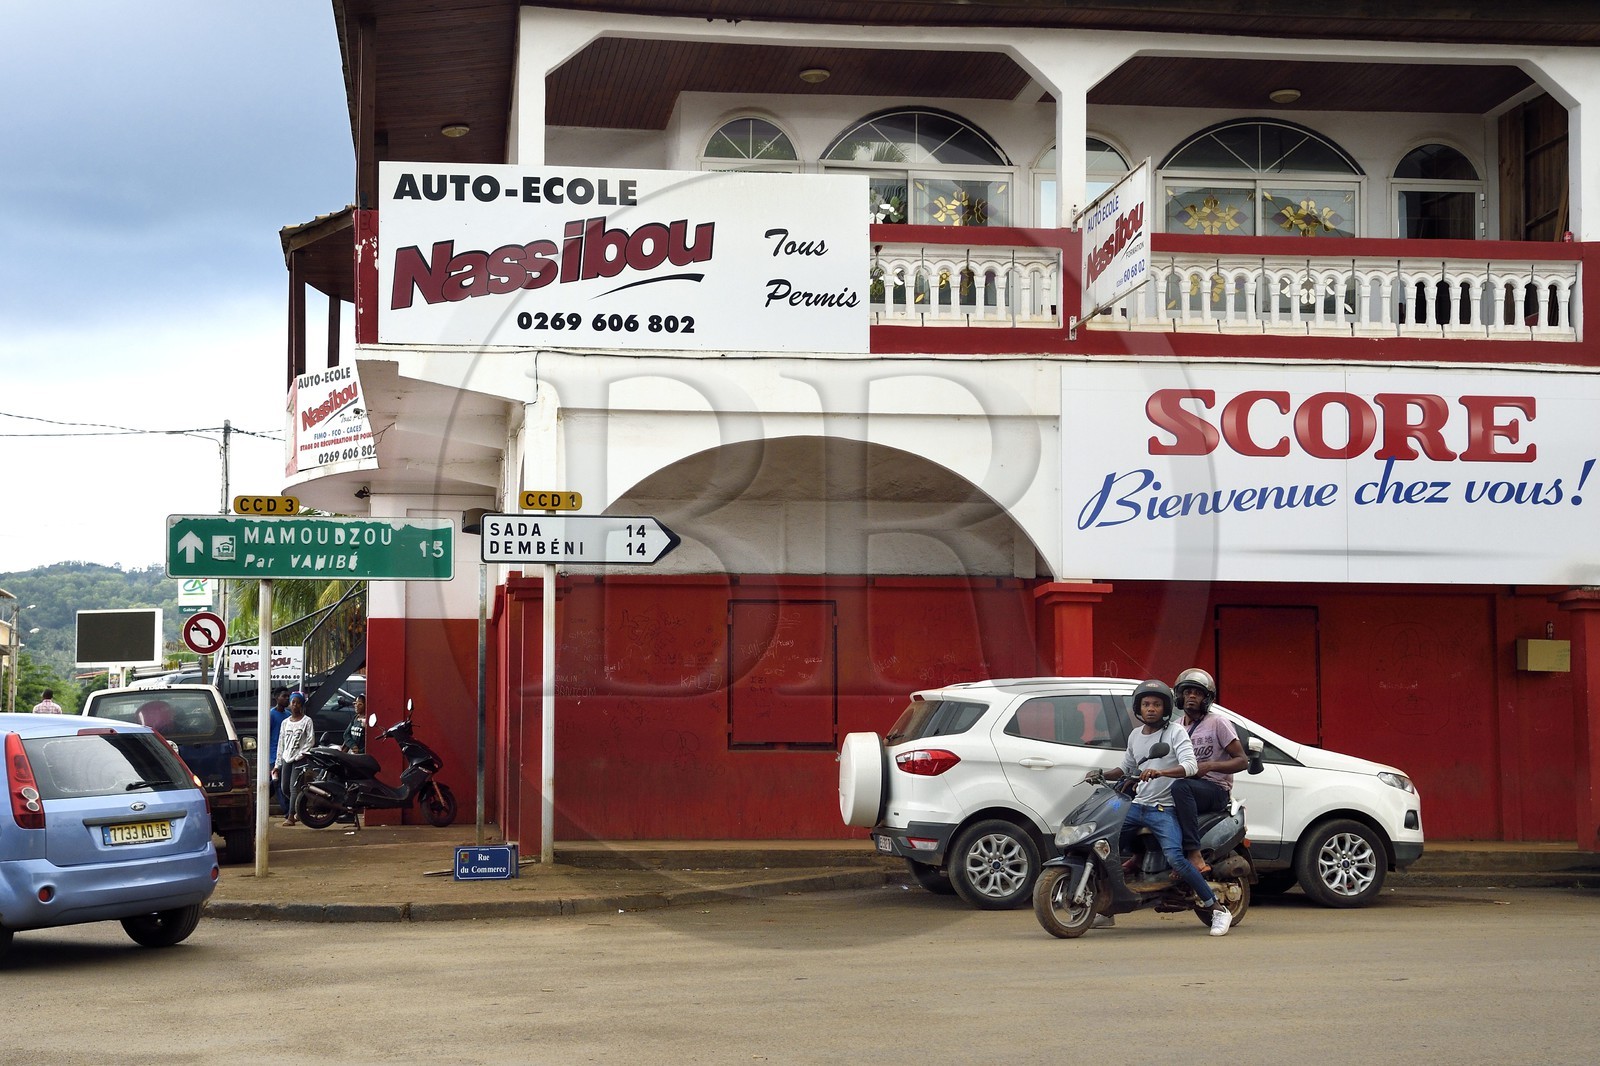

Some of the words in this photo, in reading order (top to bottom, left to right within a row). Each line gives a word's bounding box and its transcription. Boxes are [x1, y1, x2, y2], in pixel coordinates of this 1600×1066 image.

[393, 173, 637, 206] AUTO-ECOLE
[1087, 209, 1101, 233] AUTO
[1102, 195, 1119, 221] ECOLE
[764, 228, 828, 258] Tous
[1086, 201, 1144, 291] Nassibou
[391, 216, 715, 310] Nassibou
[1124, 268, 1130, 282] 60
[1138, 259, 1145, 273] 02
[764, 279, 861, 309] Permis
[517, 312, 582, 331] 0269
[591, 313, 640, 332] 606
[648, 315, 695, 334] 802
[297, 367, 351, 389] AUTO-ECOLE
[302, 382, 358, 432] Nassibou
[1145, 388, 1537, 463] SCORE
[318, 451, 340, 464] 0269
[342, 447, 359, 460] 606
[525, 493, 561, 507] CCD
[569, 494, 576, 507] 1
[1077, 468, 1338, 531] Bienvenue
[1354, 455, 1452, 504] chez
[239, 498, 277, 512] CCD
[284, 499, 294, 512] 3
[490, 523, 542, 537] SADA
[626, 525, 646, 538] 14
[244, 526, 393, 546] MAMOUDZOU
[419, 540, 444, 558] 15
[490, 538, 584, 555] DEMBÉNI
[626, 543, 646, 556] 14
[244, 555, 275, 568] Par
[110, 825, 139, 842] 7733
[141, 824, 154, 839] AD
[478, 853, 490, 861] Rue
[460, 866, 469, 874] du
[471, 866, 507, 874] Commerce
